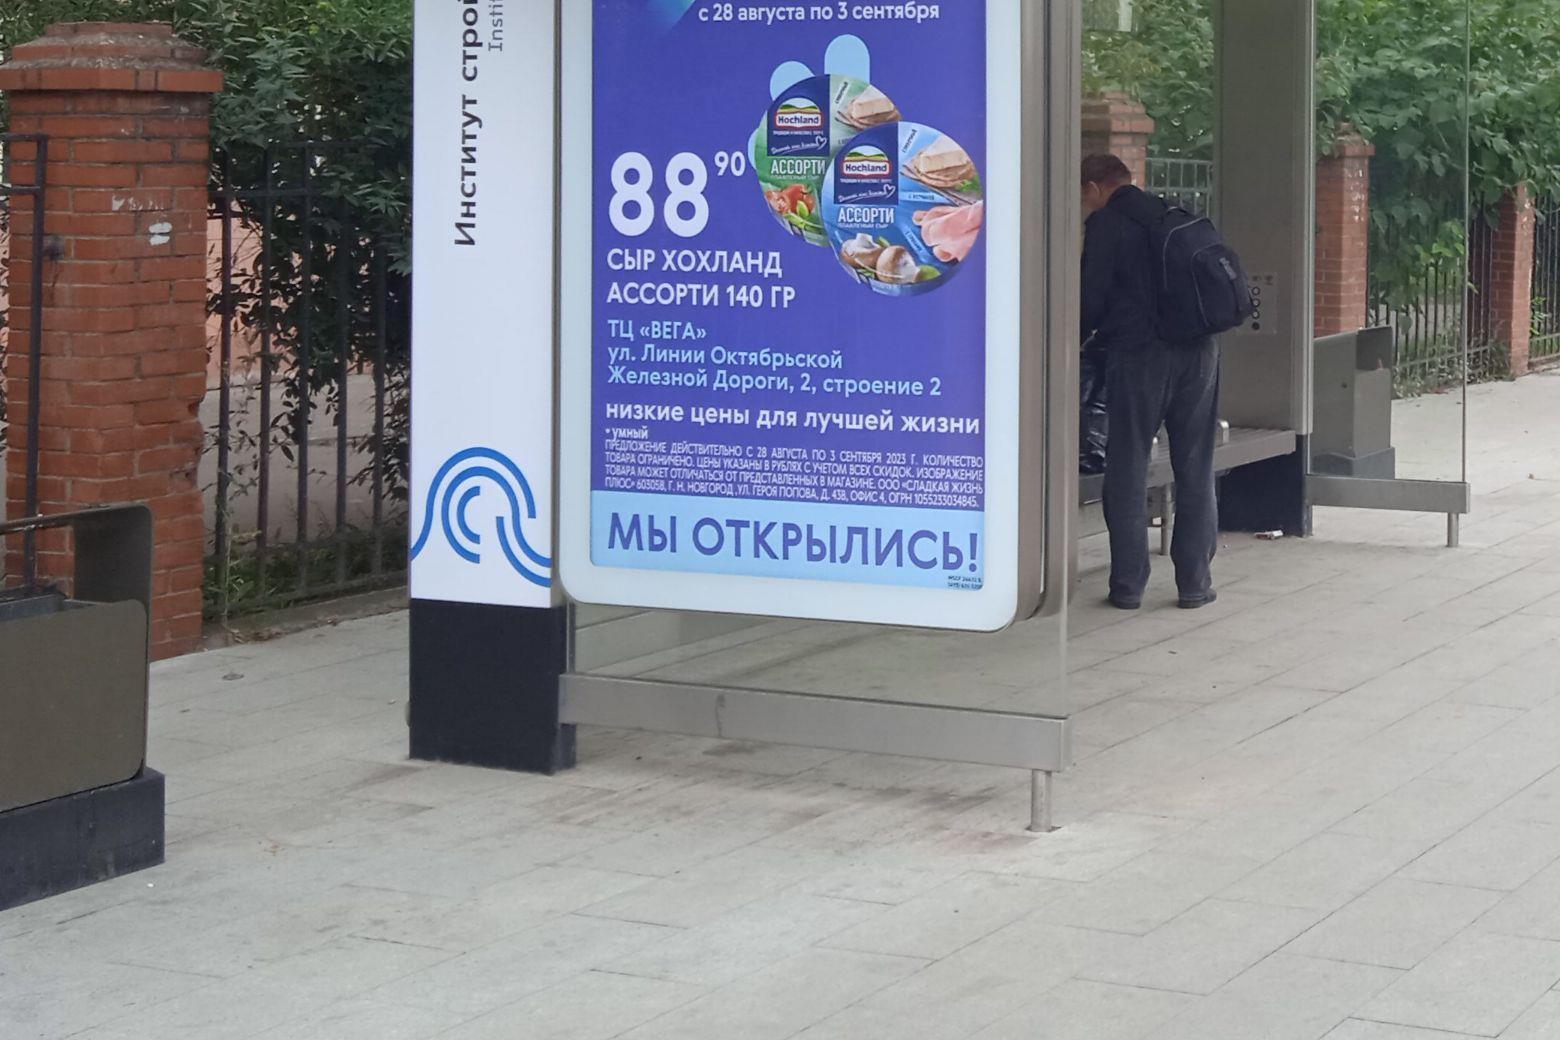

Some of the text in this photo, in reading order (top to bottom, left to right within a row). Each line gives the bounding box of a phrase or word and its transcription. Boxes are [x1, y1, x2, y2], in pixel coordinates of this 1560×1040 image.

[698, 1, 940, 26] с 28 августа по 3 сентября
[777, 114, 820, 125] Hochland
[454, 94, 484, 247] Институт
[770, 159, 826, 175] АССОРТИ
[844, 162, 888, 173] Hochland
[608, 151, 710, 237] 88
[838, 207, 895, 224] АССОРТИ
[606, 248, 783, 279] СЫР ХОХЛАНД
[606, 282, 797, 309] АССОРТИ 140 ГР
[608, 319, 707, 342] ТЦ «ВЕГА»
[608, 344, 844, 370] ул. Линии Октябрьской
[608, 365, 943, 399] Железной Дороги, 2, строение 2
[605, 402, 981, 436] низкие цены для лучшей жизни
[604, 438, 667, 453] ПРЕДЛОЖЕНИЕ
[670, 440, 743, 456] ДЕЙСТВИТЕЛЬНО
[745, 445, 753, 457] С
[756, 446, 768, 458] 28
[771, 446, 808, 460] АВГУСТА
[812, 449, 827, 461] ПО
[829, 450, 836, 461] 3
[839, 450, 882, 464] СЕНТЯБРЯ
[886, 452, 907, 465] 2023
[922, 454, 983, 468] КОЛИЧЕСТВО
[604, 451, 637, 464] ТОВАРА
[637, 453, 696, 468] ОГРАНИЧЕНО.
[696, 456, 721, 470] ЦЕНЫ
[723, 457, 763, 471] УКАЗАНЫ
[764, 459, 770, 471] В
[771, 459, 803, 473] РУБЛЯХ
[812, 461, 847, 475] УЧЕТОМ
[849, 463, 872, 476] ВСЕХ
[872, 464, 914, 479] СКИДОК.
[915, 467, 984, 482] ИЗОБРАЖЕНИЕ
[604, 463, 637, 476] ТОВАРА
[637, 465, 669, 479] МОЖЕТ
[669, 466, 724, 482] ОТЛИЧАТЬСЯ
[725, 470, 738, 482] ОТ
[738, 471, 819, 487] ПРЕДСТАВЛЕННЫХ
[877, 478, 900, 491] ООО
[951, 481, 983, 495] ЖИЗНЬ
[687, 482, 734, 497] НОВГОРОД
[752, 484, 778, 498] ГЕРОЯ
[850, 489, 879, 504] ОФИС
[888, 491, 912, 505] ОГРН
[606, 512, 979, 573] МЫ ОТКРЫЛИСЬ!
